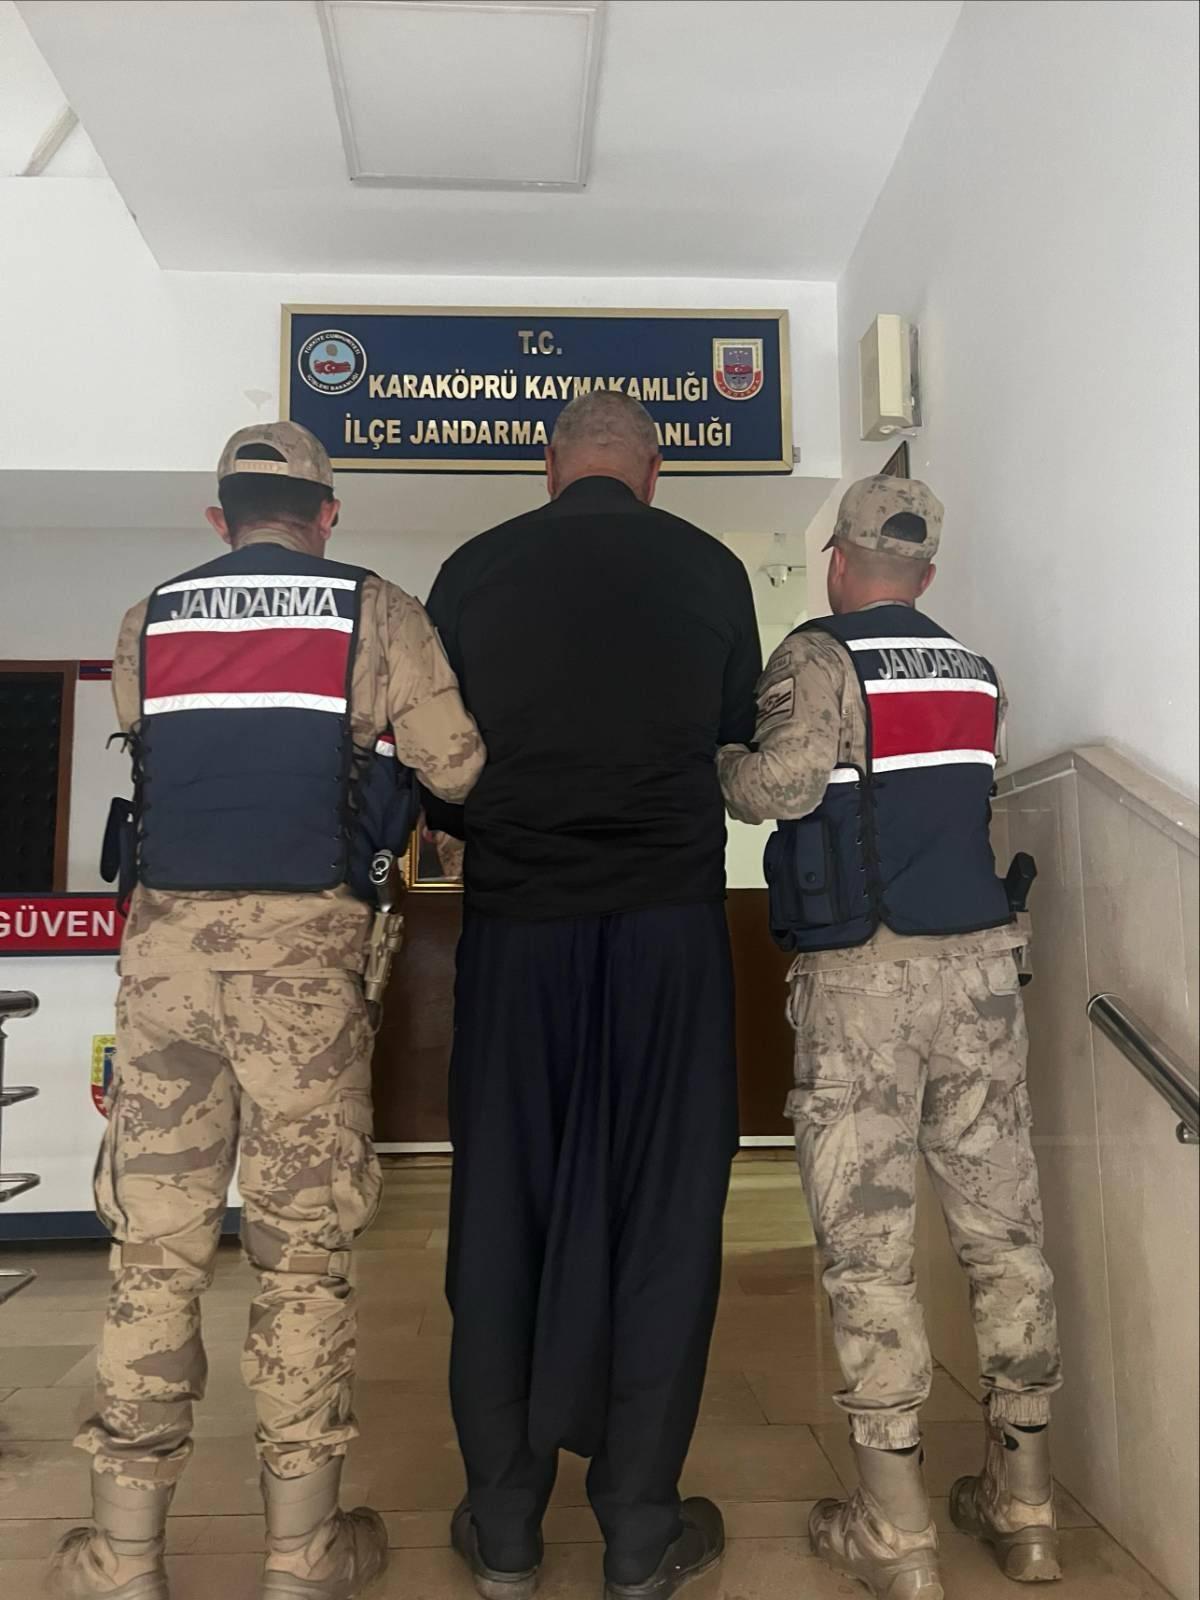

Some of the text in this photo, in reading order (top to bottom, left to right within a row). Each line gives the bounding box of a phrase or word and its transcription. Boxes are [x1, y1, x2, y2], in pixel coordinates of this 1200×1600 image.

[518, 330, 563, 355] T.C.
[368, 368, 518, 400] KARAKÖPRÜ
[525, 371, 708, 401] KAYMAKAMLIĞI
[344, 413, 401, 450] İLÇE
[409, 420, 549, 445] JANDARMA
[170, 586, 339, 620] JANDARMA
[878, 648, 991, 681] JANDARMA
